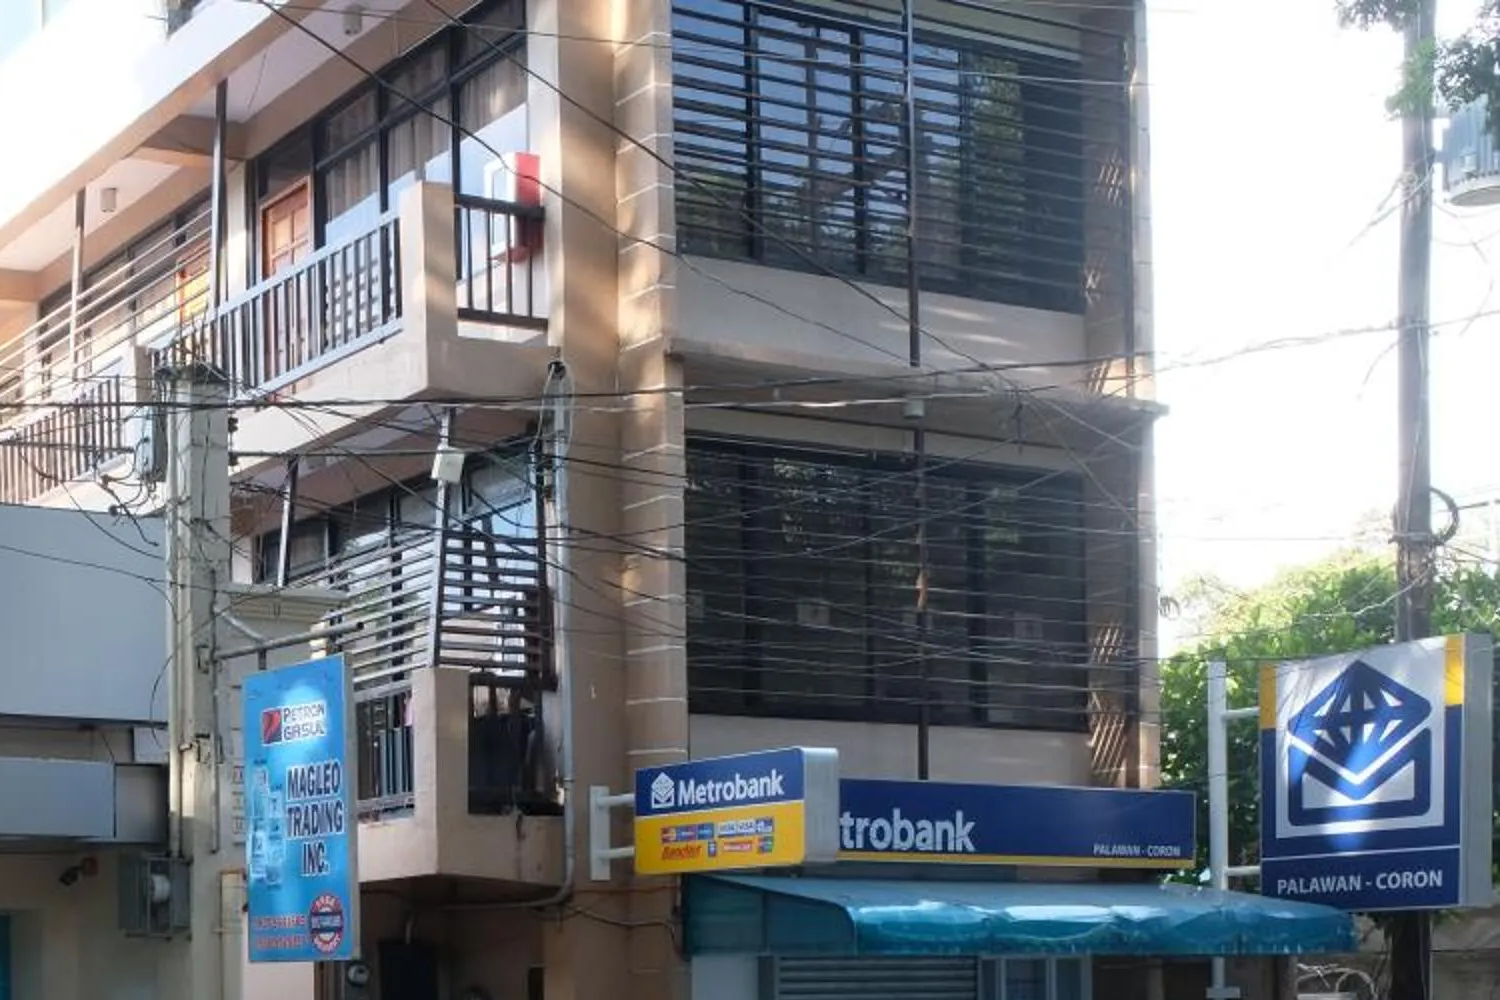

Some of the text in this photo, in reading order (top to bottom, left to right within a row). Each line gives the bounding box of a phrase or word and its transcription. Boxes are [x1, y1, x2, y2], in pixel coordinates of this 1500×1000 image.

[283, 703, 325, 722] PETRON
[284, 721, 325, 741] GASUL
[287, 760, 341, 801] MAGLEO
[677, 768, 785, 807] Metrobank
[287, 799, 343, 838] TRADING
[839, 807, 976, 853] trobank
[1093, 843, 1140, 856] PALAWAN
[1147, 845, 1181, 857] CORON
[1277, 874, 1361, 895] PALAWAN
[1375, 870, 1443, 890] CORON
